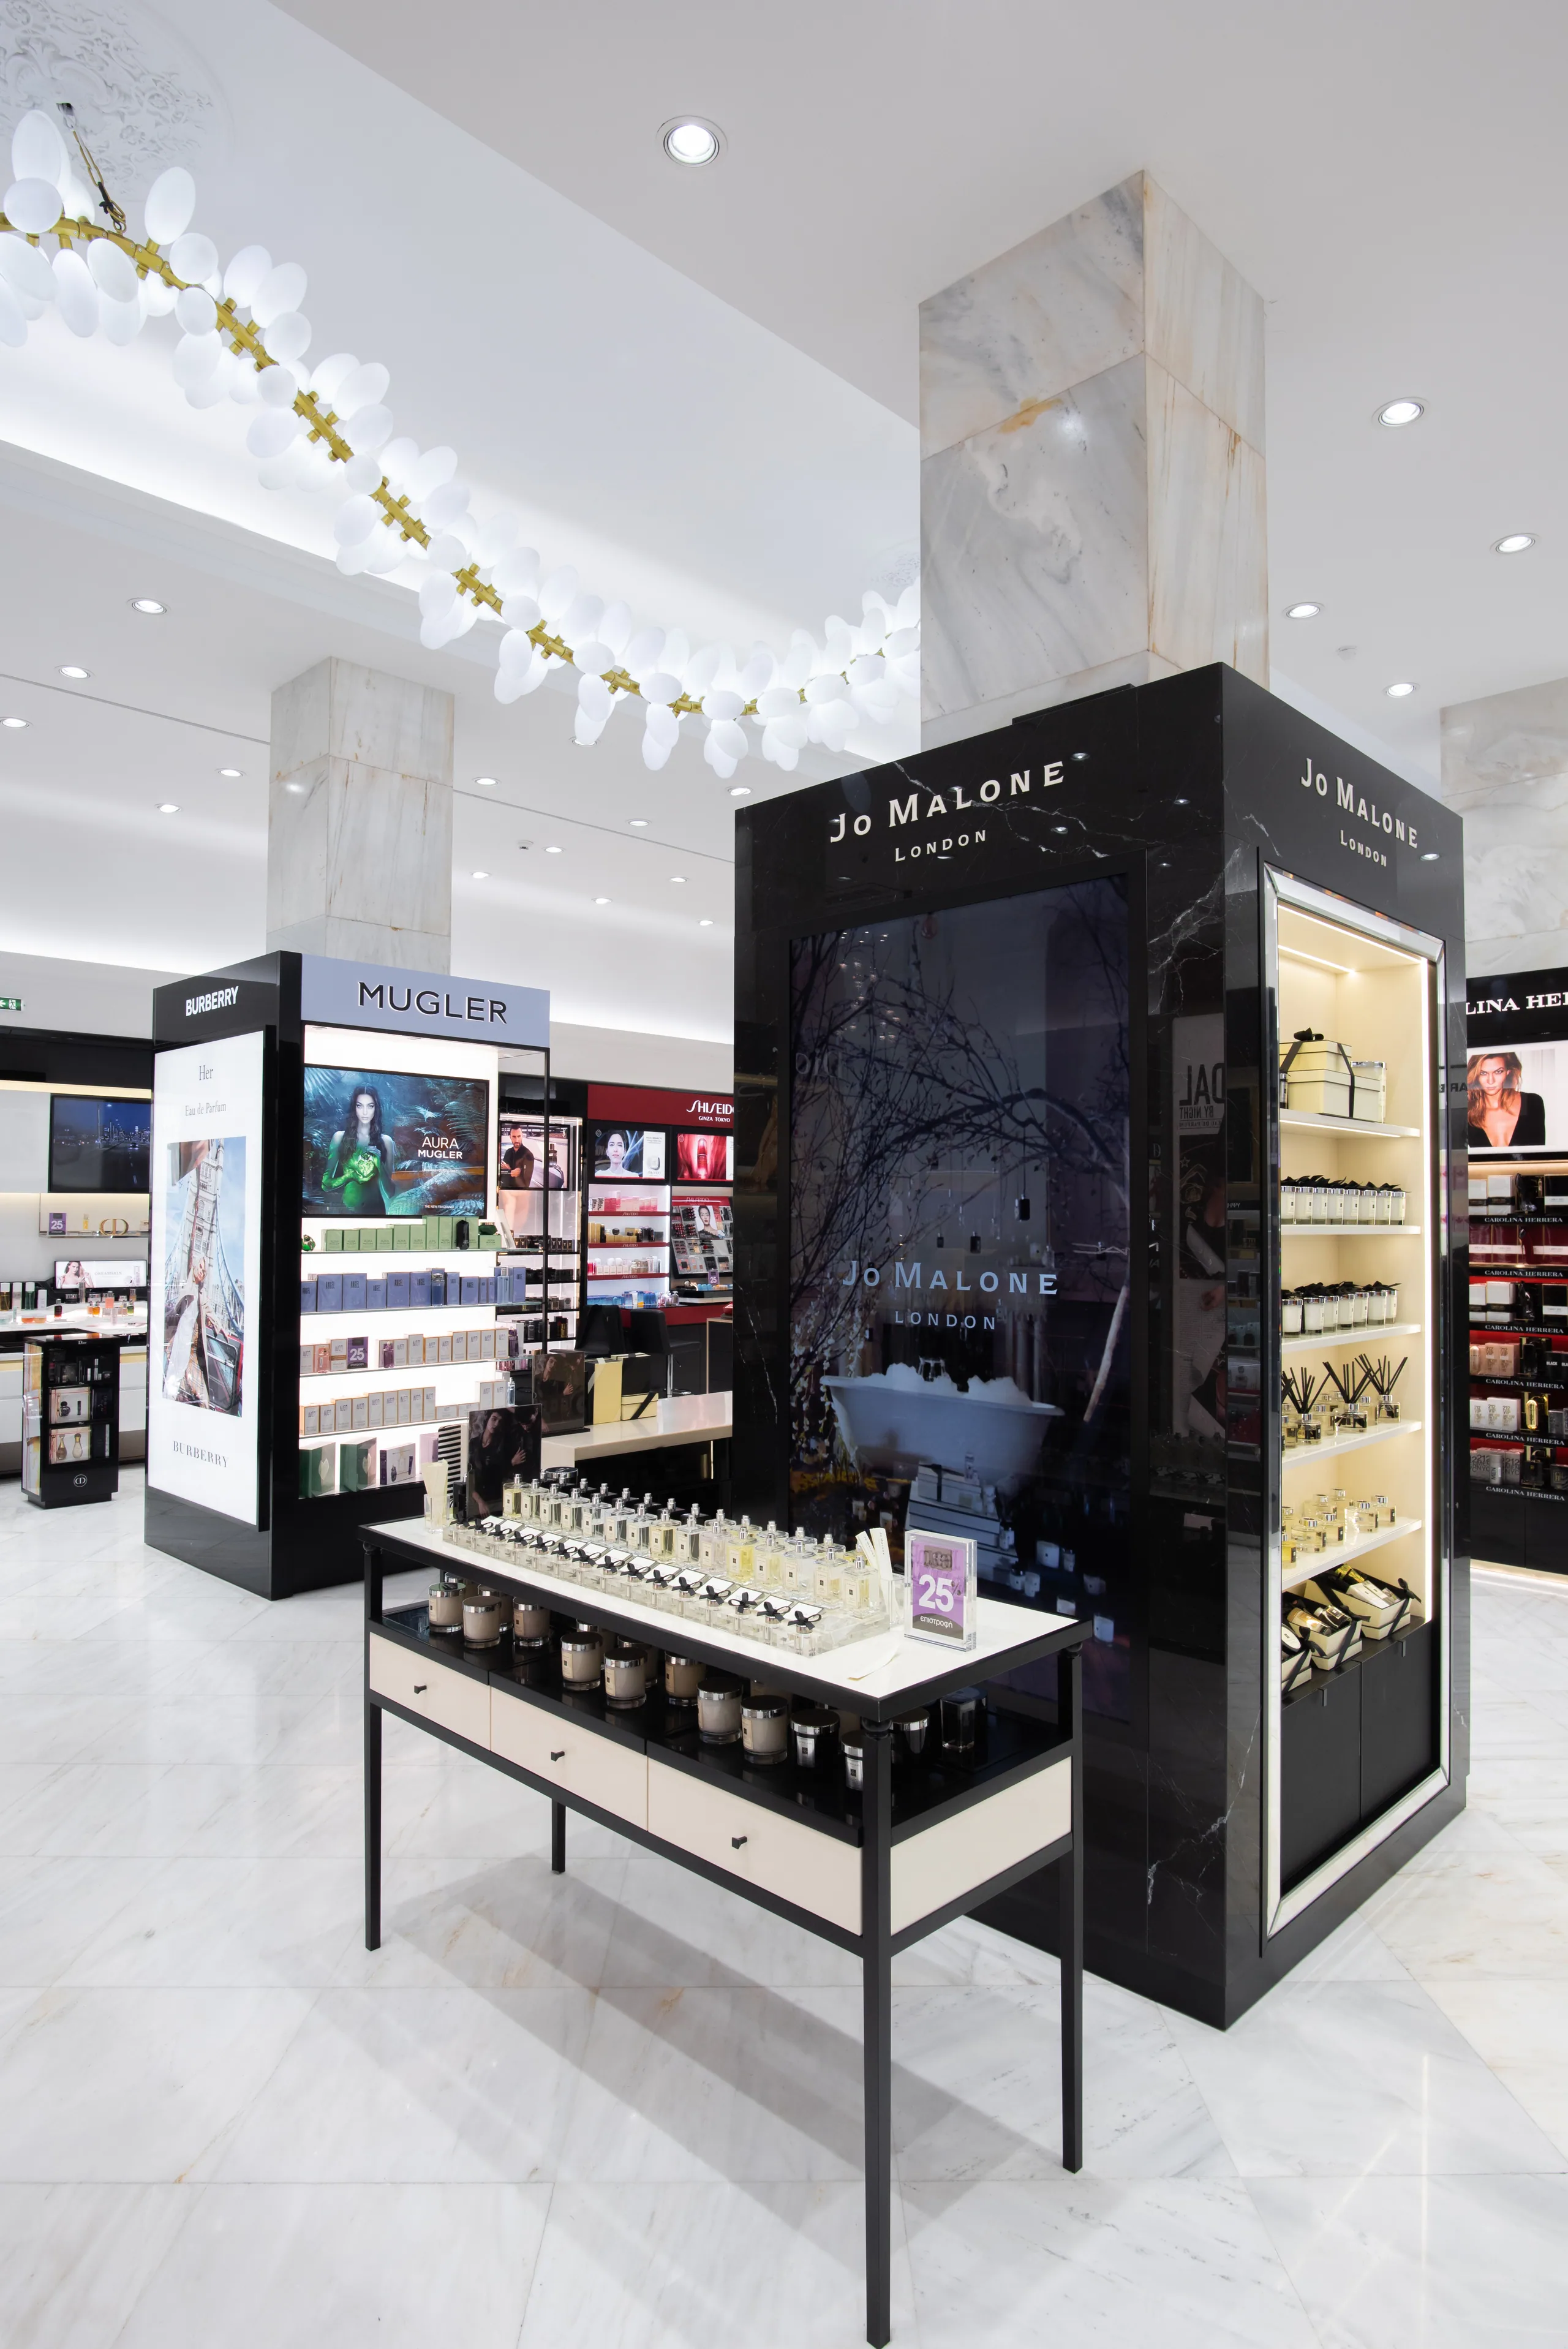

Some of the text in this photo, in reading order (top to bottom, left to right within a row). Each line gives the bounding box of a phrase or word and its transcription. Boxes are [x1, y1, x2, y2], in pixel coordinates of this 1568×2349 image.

[889, 761, 1064, 827] MALONE
[1336, 777, 1417, 848] MALONE
[895, 830, 986, 862] LONDON
[1340, 830, 1387, 867] LONDON
[186, 986, 239, 1016] BURBERRY
[358, 981, 507, 1024] MUGLER
[199, 1065, 213, 1080] Her
[185, 1100, 227, 1116] Eau de Parfum
[686, 1100, 734, 1114] SHISEID
[418, 1150, 463, 1159] MUGLER
[422, 1137, 459, 1149] AURA
[895, 1262, 1058, 1294] MALONE
[895, 1311, 995, 1330] LONDON
[1486, 1433, 1525, 1441] CAROLINA
[173, 1441, 229, 1468] BURBERRY
[1486, 1486, 1565, 1501] CAROLINA HERRERA
